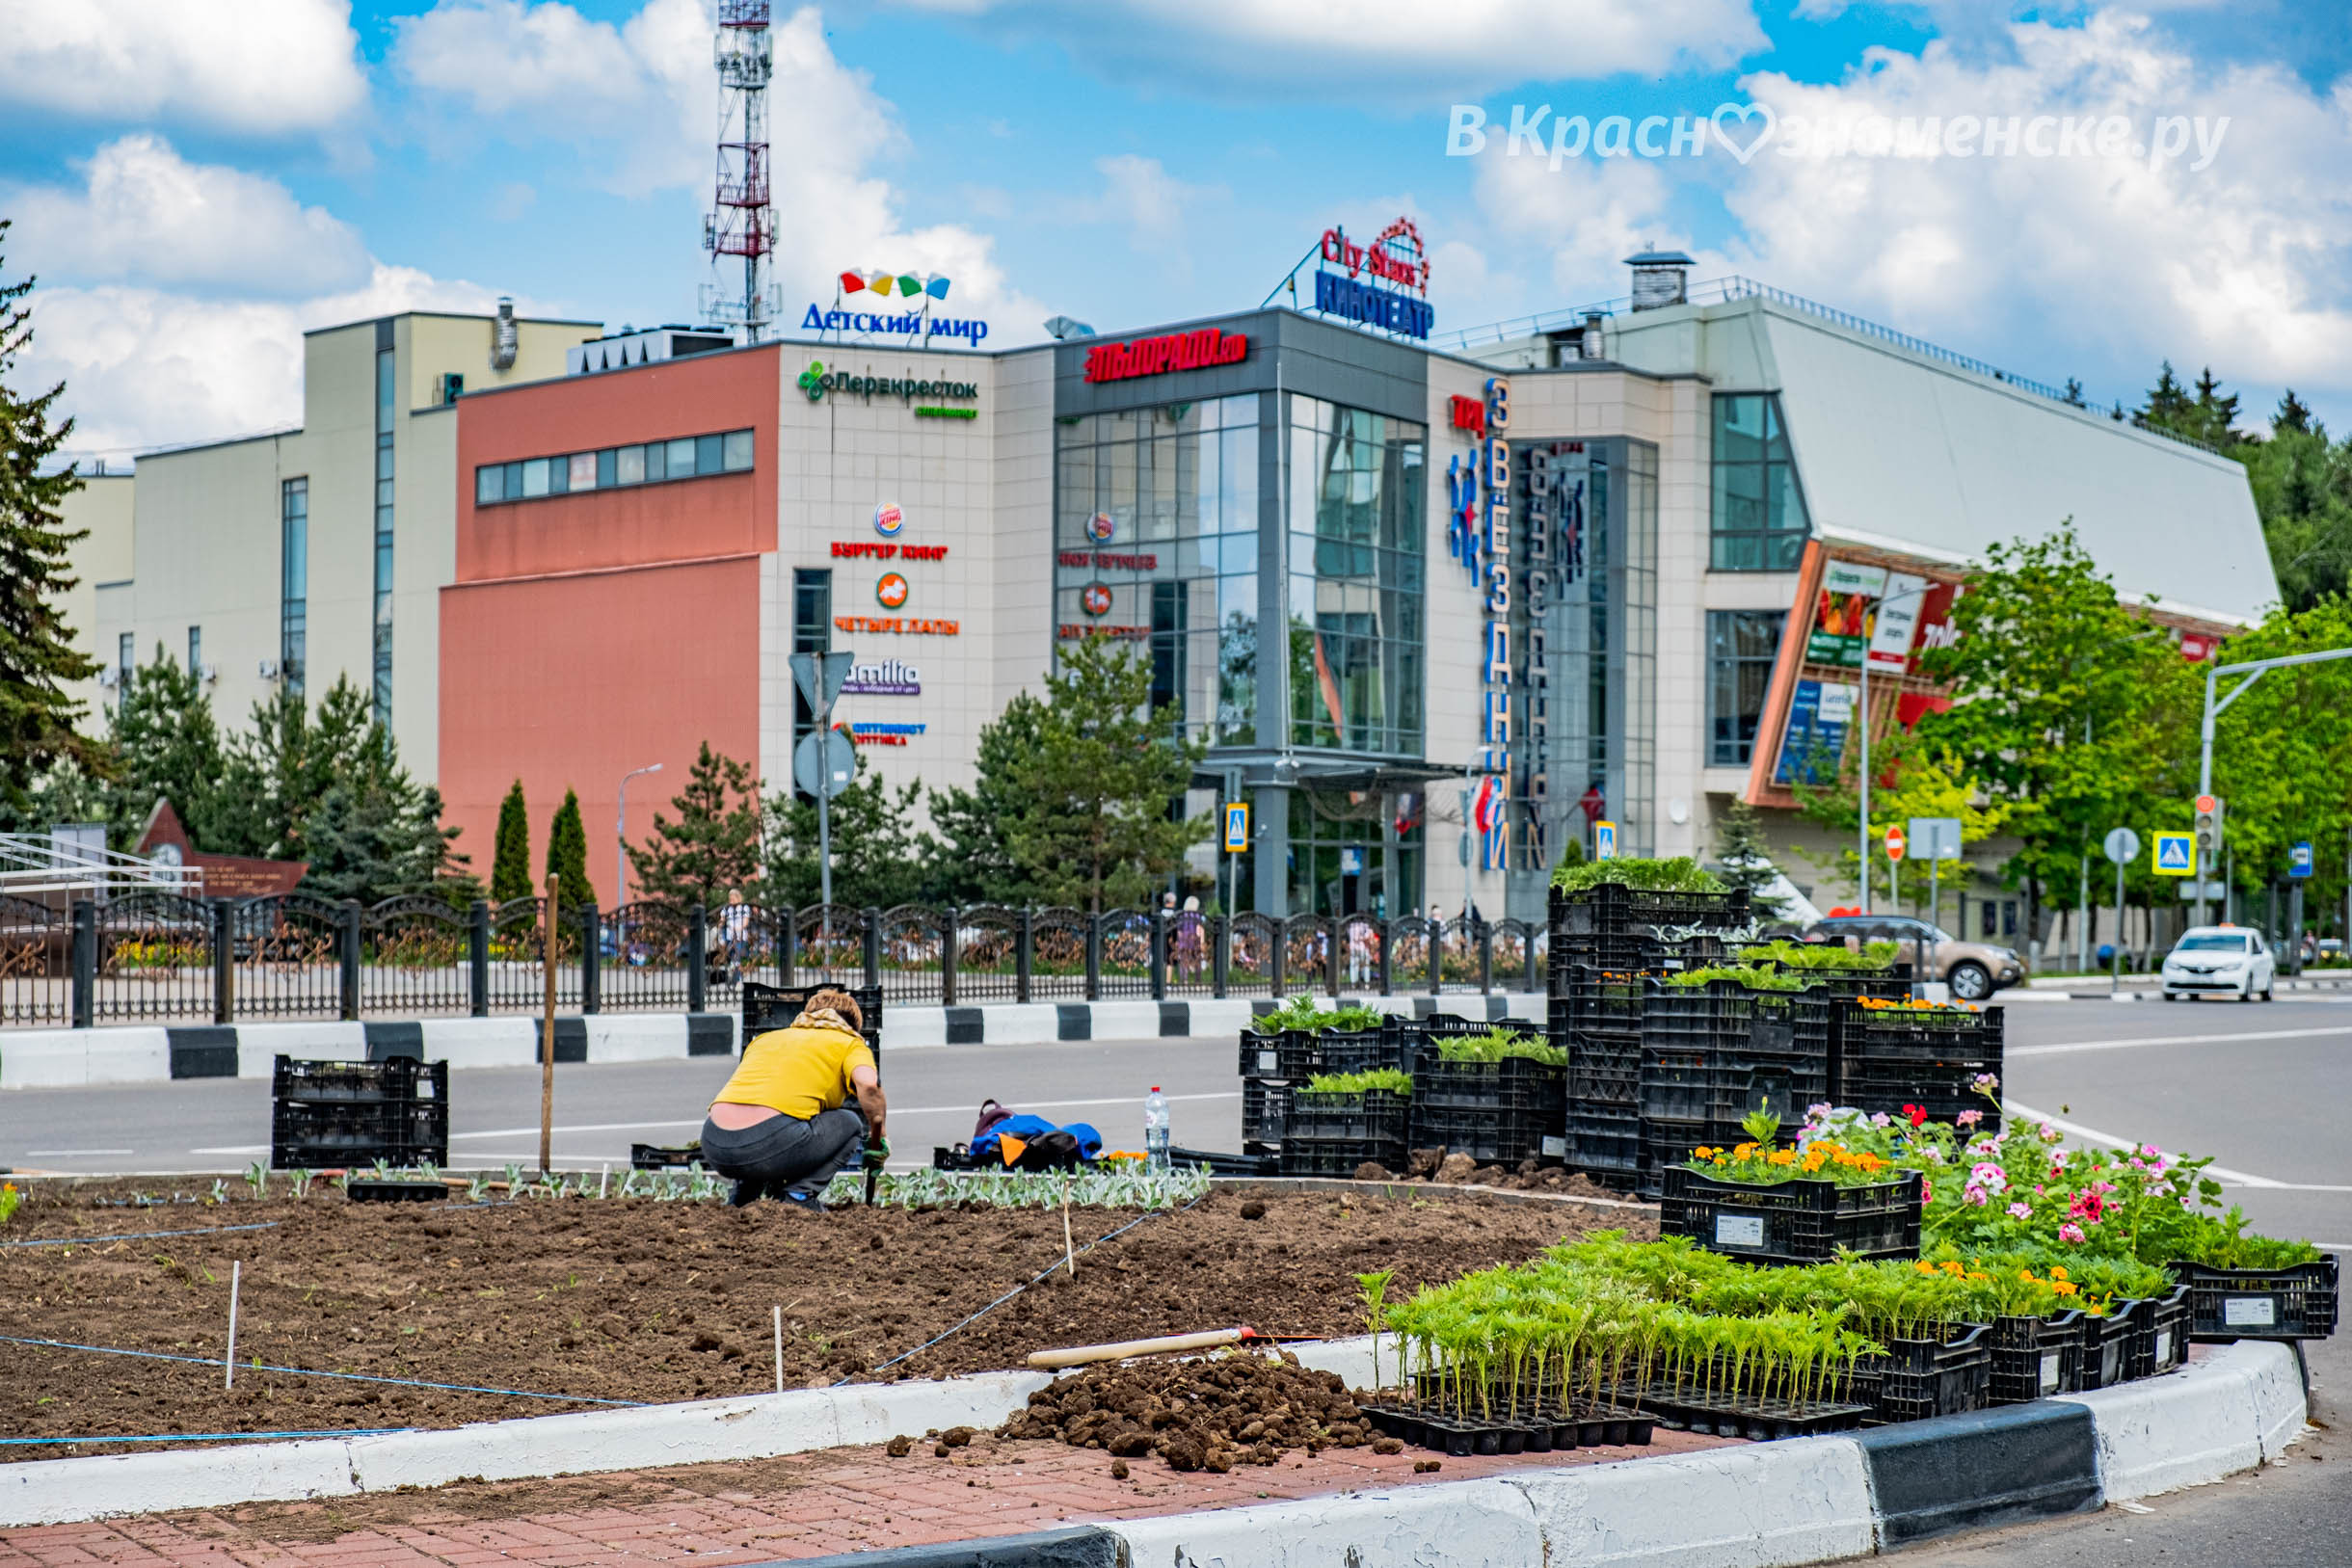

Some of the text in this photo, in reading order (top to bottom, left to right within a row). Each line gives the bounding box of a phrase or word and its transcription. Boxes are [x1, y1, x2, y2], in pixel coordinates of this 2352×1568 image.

[801, 303, 988, 347] Детский мир
[836, 371, 978, 399] Перекресток
[831, 541, 949, 561] БУРГЕР КИНГ
[835, 616, 960, 636] ЧЕТЫРЕ ЛАПЫ
[845, 659, 920, 684] amilia
